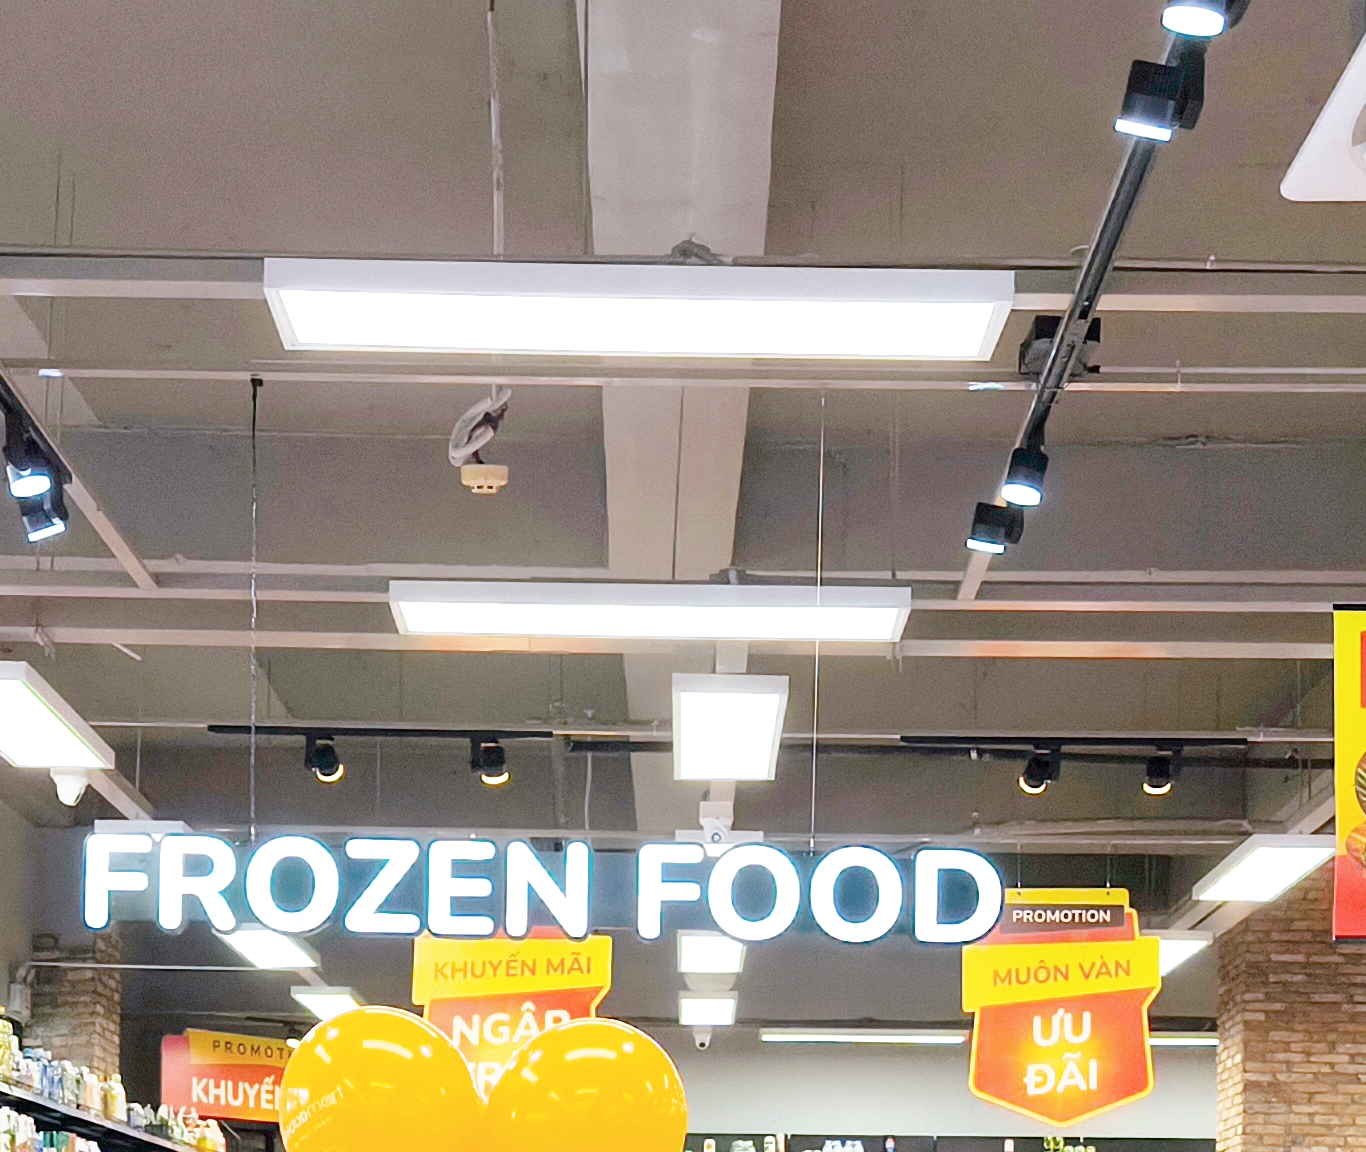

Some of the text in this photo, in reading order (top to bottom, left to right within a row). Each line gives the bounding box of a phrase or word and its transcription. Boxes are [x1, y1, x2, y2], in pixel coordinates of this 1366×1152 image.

[83, 833, 1004, 945] FROZEN FOOD
[1012, 909, 1111, 923] PROMOTION
[434, 951, 592, 982] KHUYẾN MÃI
[993, 955, 1131, 987] MUÔN VÀN
[1032, 1007, 1092, 1047] ƯU
[1023, 1051, 1098, 1096] ĐÃI
